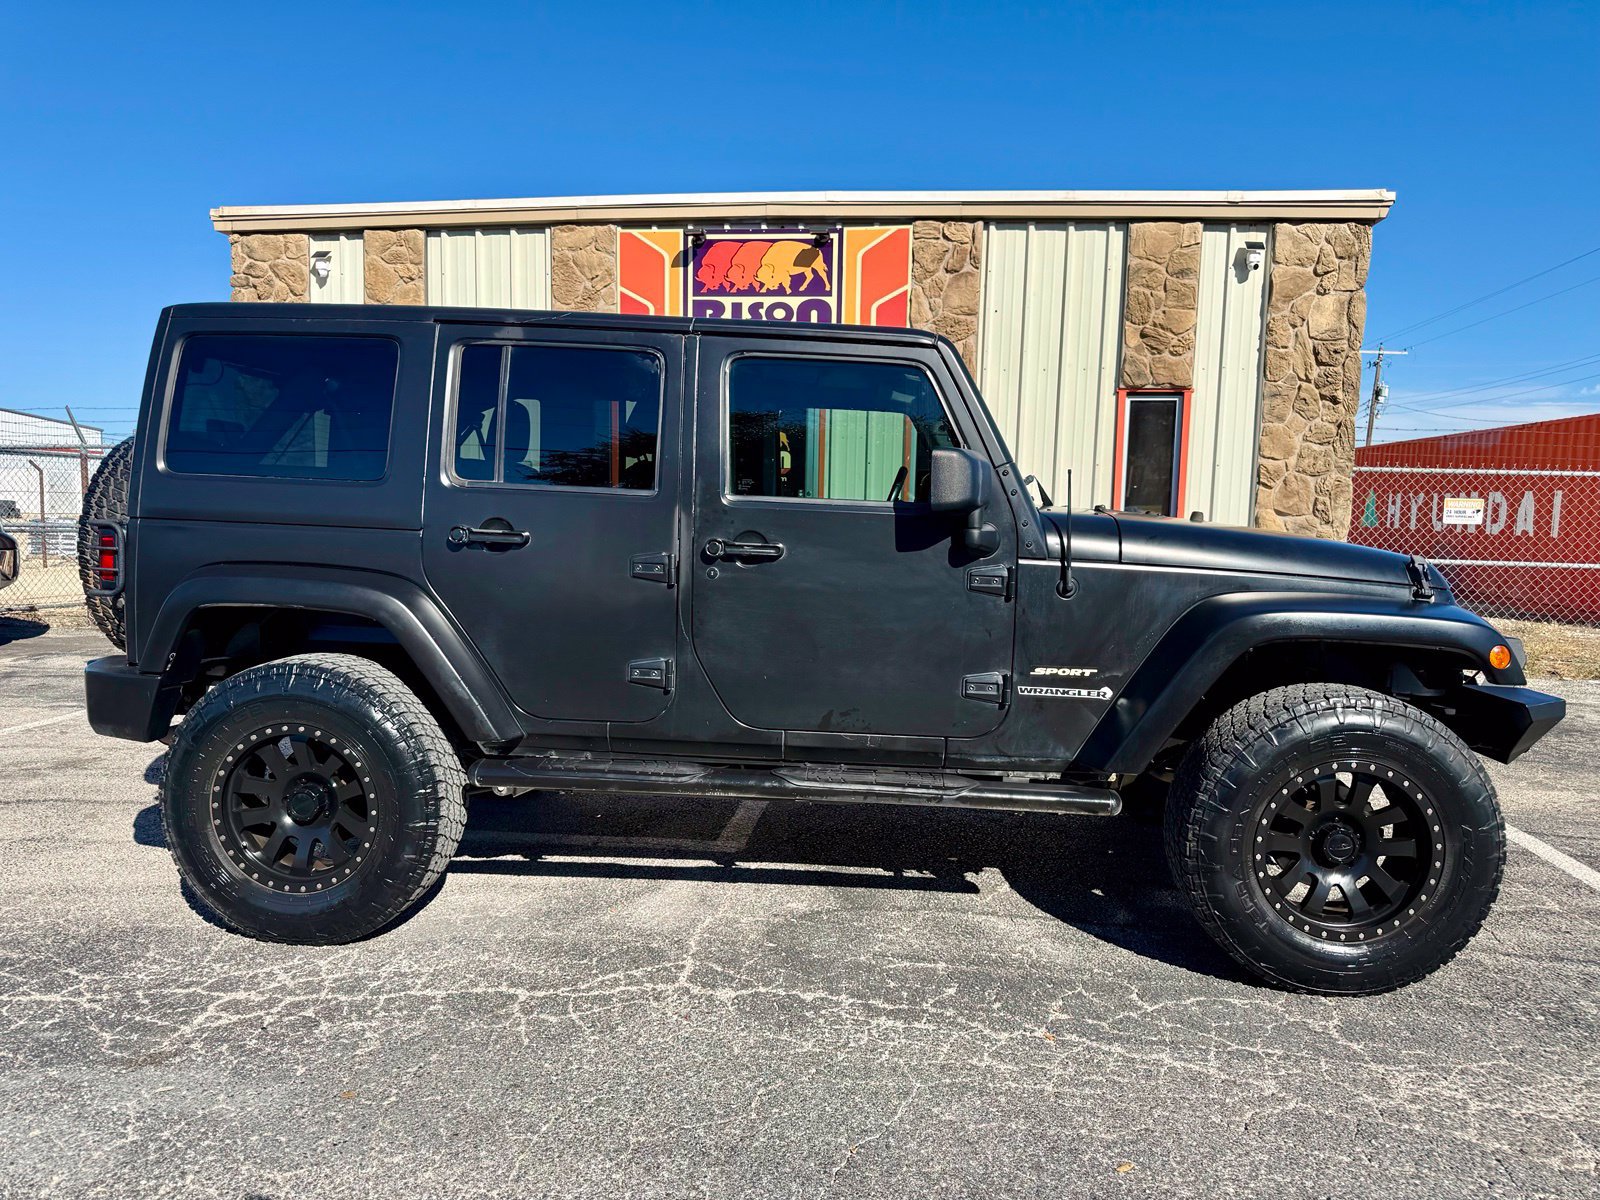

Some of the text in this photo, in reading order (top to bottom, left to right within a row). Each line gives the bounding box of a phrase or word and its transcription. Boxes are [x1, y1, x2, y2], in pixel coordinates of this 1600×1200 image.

[1447, 500, 1481, 508] WARNING
[1029, 667, 1098, 677] SPORT
[1018, 686, 1109, 699] WRANGLER
